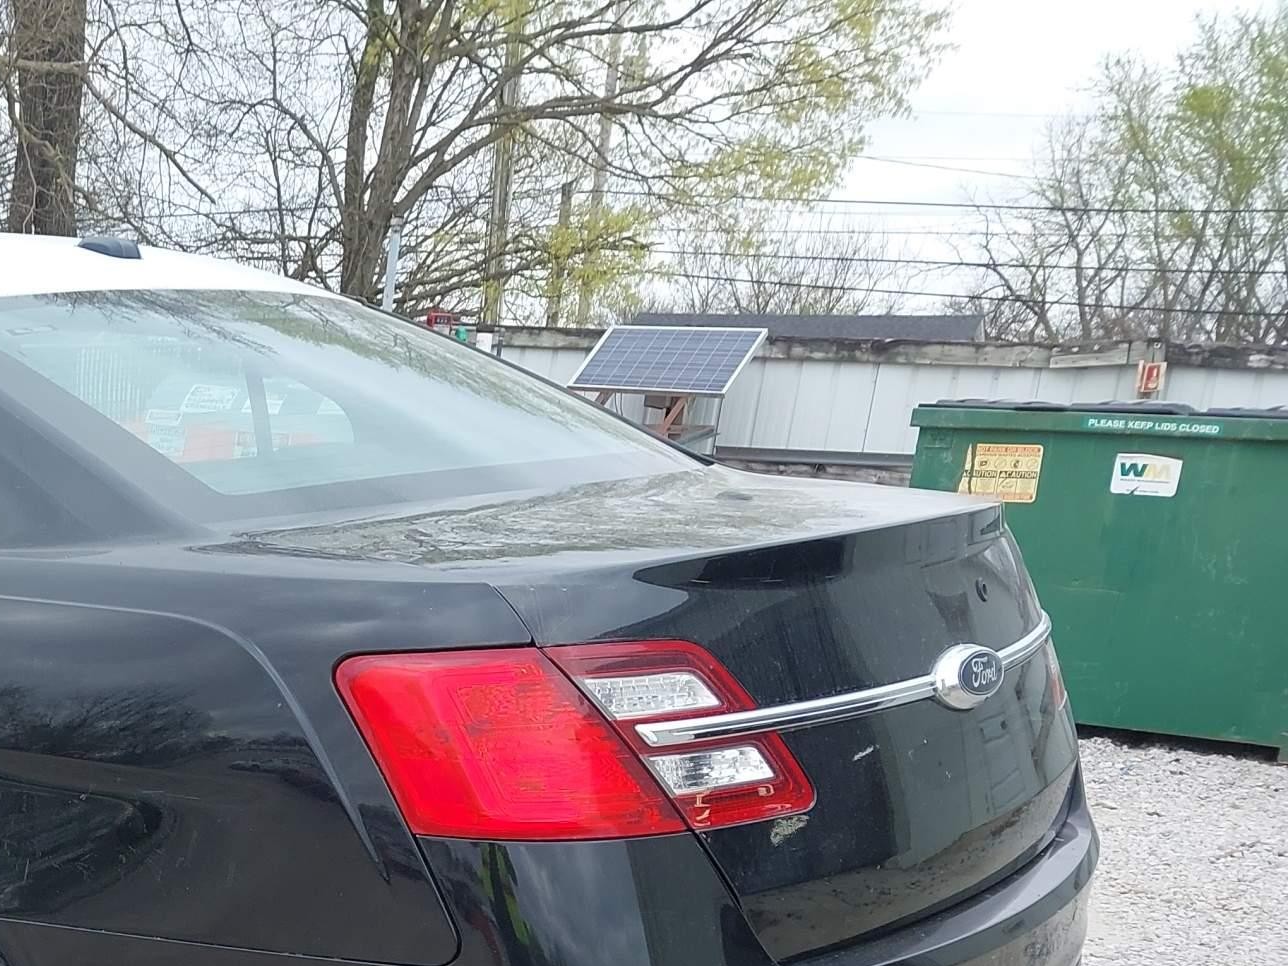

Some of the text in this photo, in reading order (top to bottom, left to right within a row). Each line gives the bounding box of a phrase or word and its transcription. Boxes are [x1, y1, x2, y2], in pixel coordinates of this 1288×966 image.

[1088, 419, 1220, 433] PLEASE KEEP LIDS CLOSED
[1007, 471, 1037, 479] CAUTION
[972, 656, 997, 688] Ford
